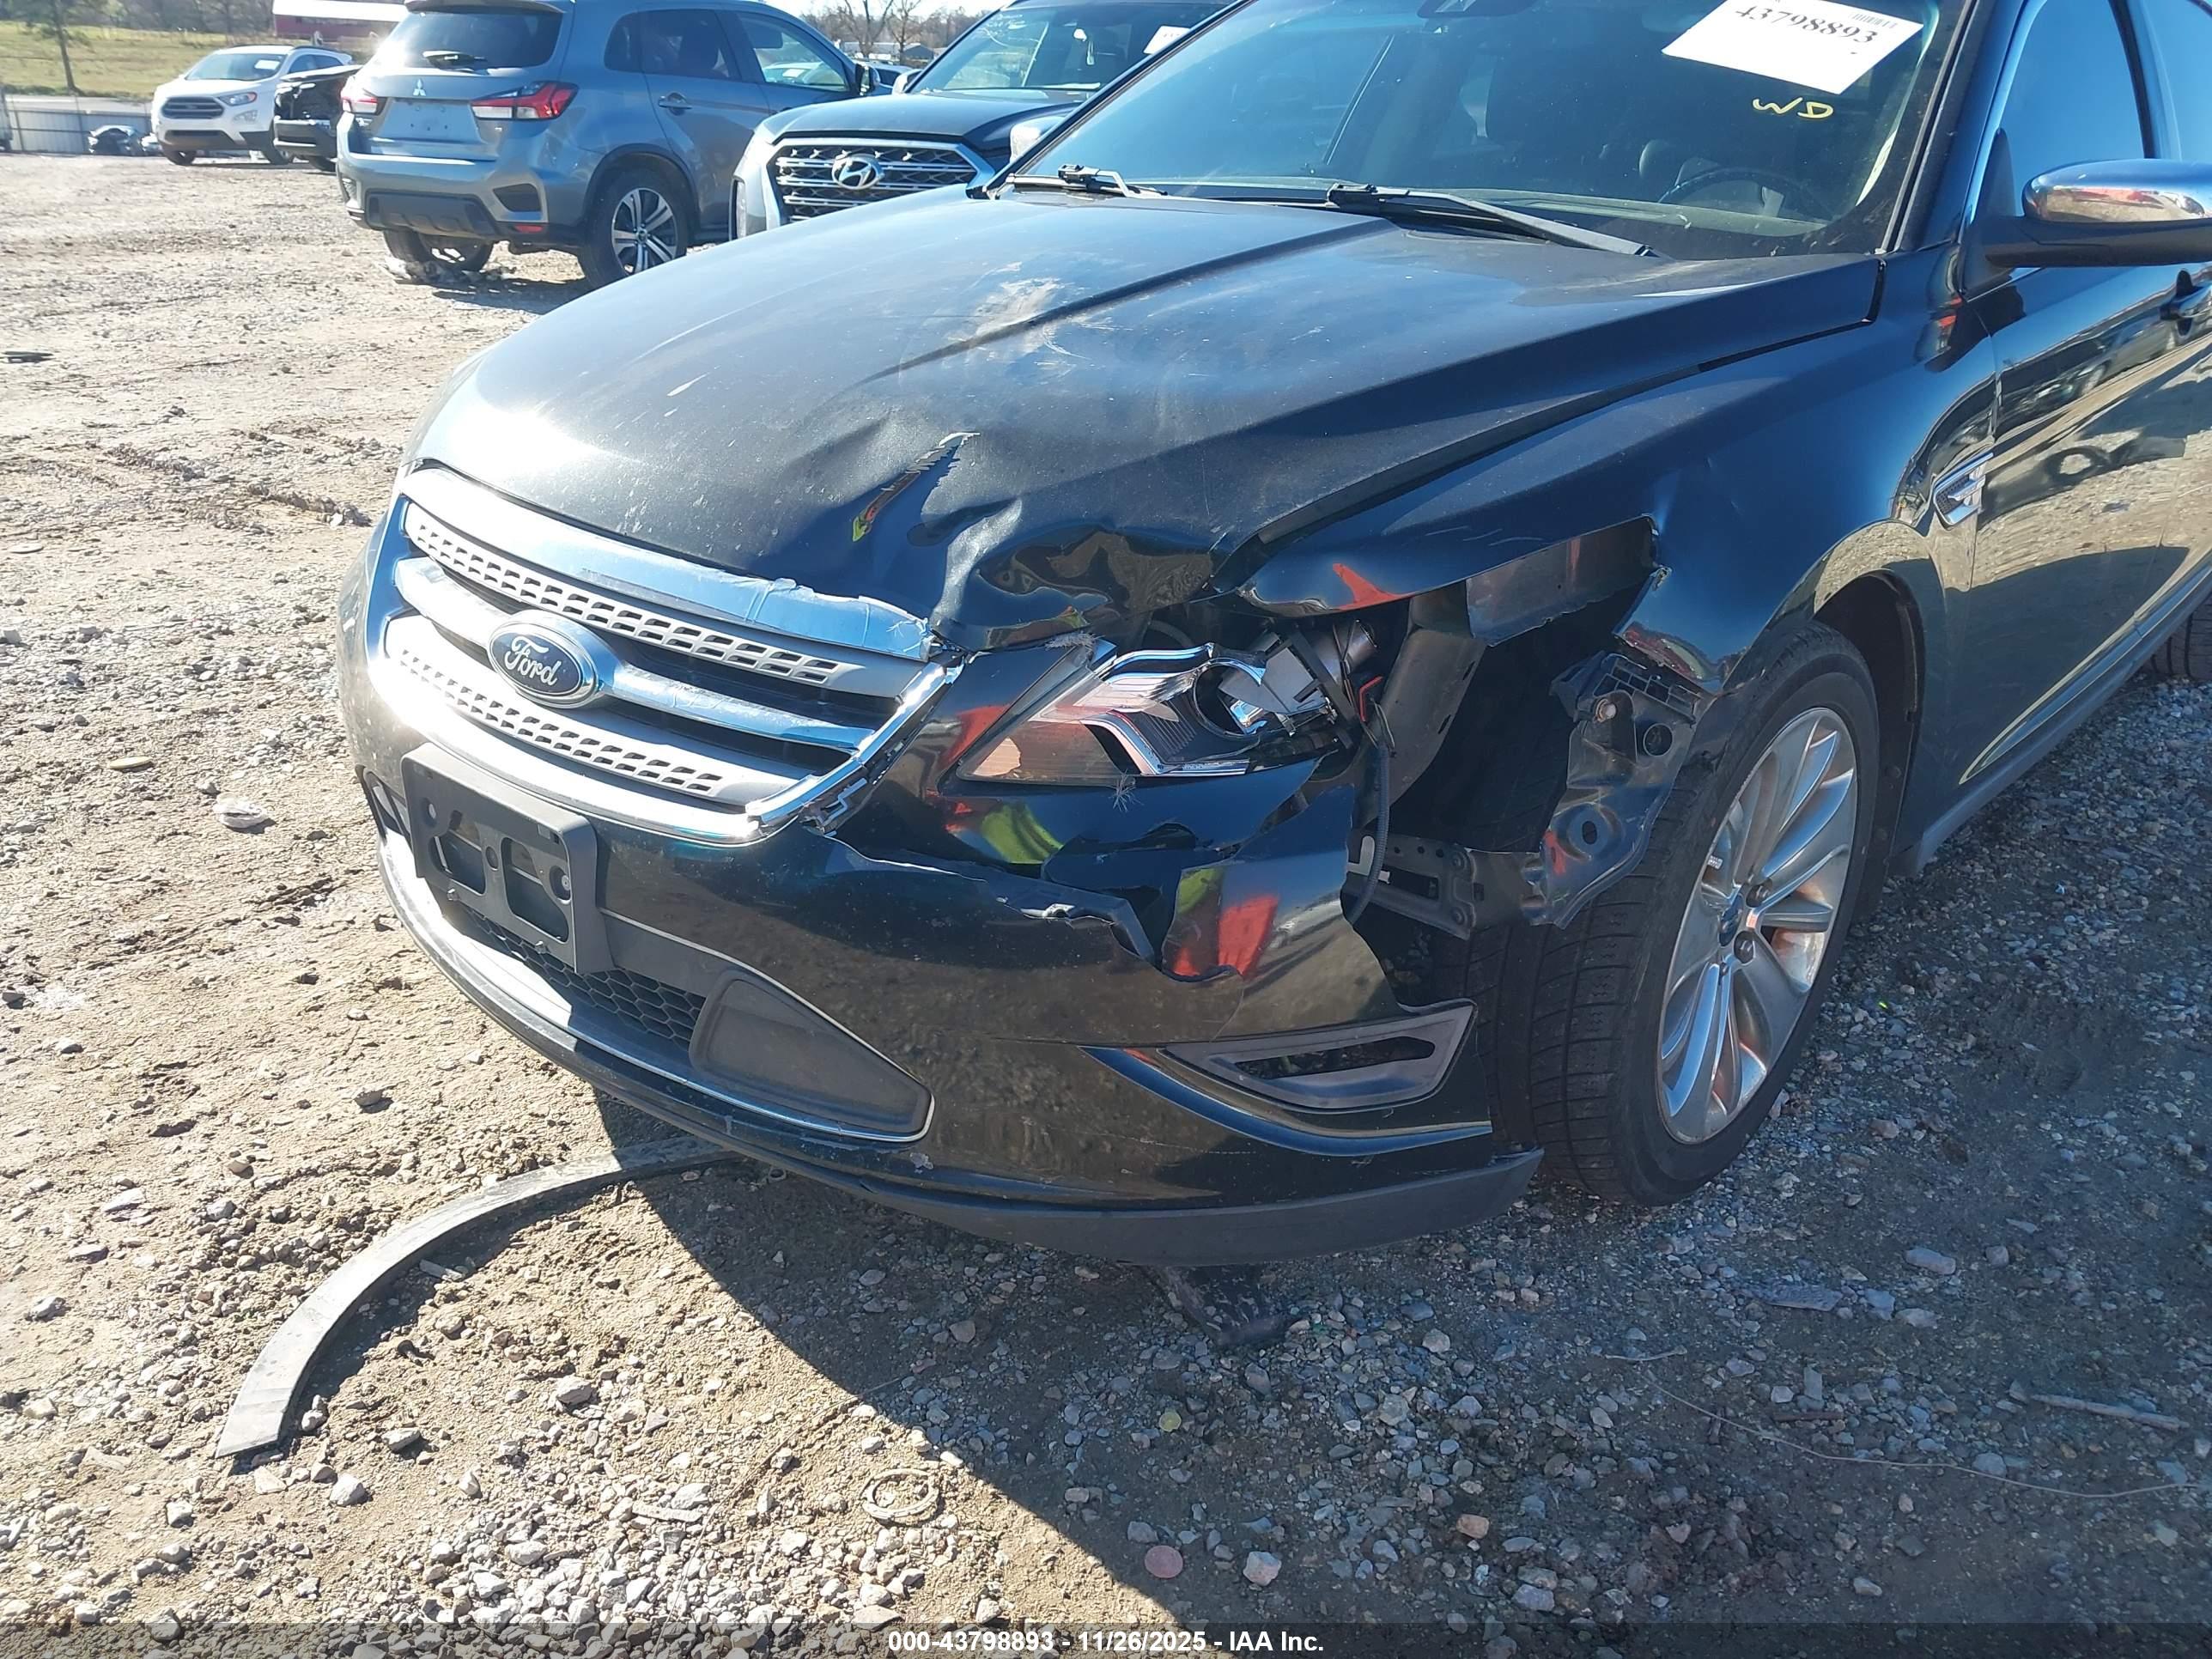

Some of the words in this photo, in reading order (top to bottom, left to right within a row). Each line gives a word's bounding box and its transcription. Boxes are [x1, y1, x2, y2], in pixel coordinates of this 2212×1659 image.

[1735, 5, 1878, 43] 43798893
[1752, 96, 1834, 119] WD
[504, 636, 562, 685] Ford
